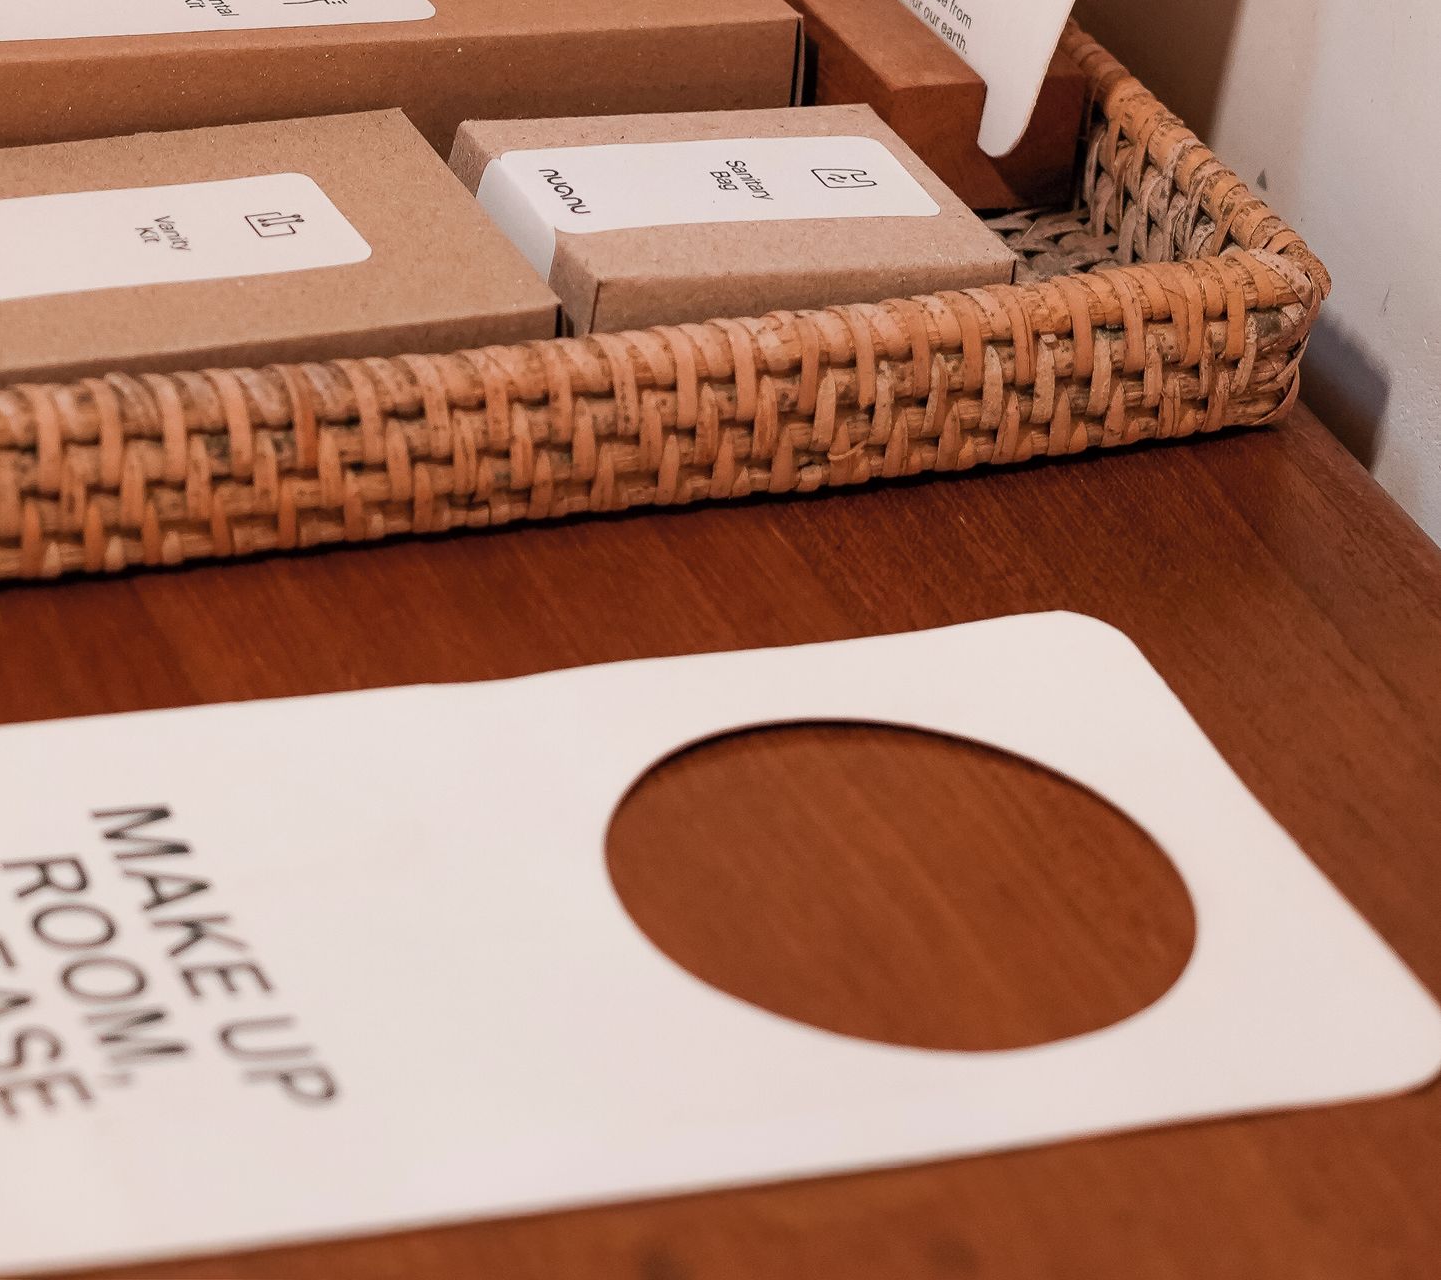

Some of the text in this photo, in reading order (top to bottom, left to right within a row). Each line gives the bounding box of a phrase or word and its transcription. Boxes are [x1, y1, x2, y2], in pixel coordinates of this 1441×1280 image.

[923, 6, 941, 28] our
[940, 22, 968, 55] earth.
[538, 168, 591, 215] nuanu
[709, 170, 739, 192] Bag
[725, 159, 774, 201] Sanitary
[134, 226, 160, 244] Kit
[153, 215, 191, 251] Vanity
[0, 852, 192, 1090] ROOM,
[90, 802, 342, 1109] MAKE UP
